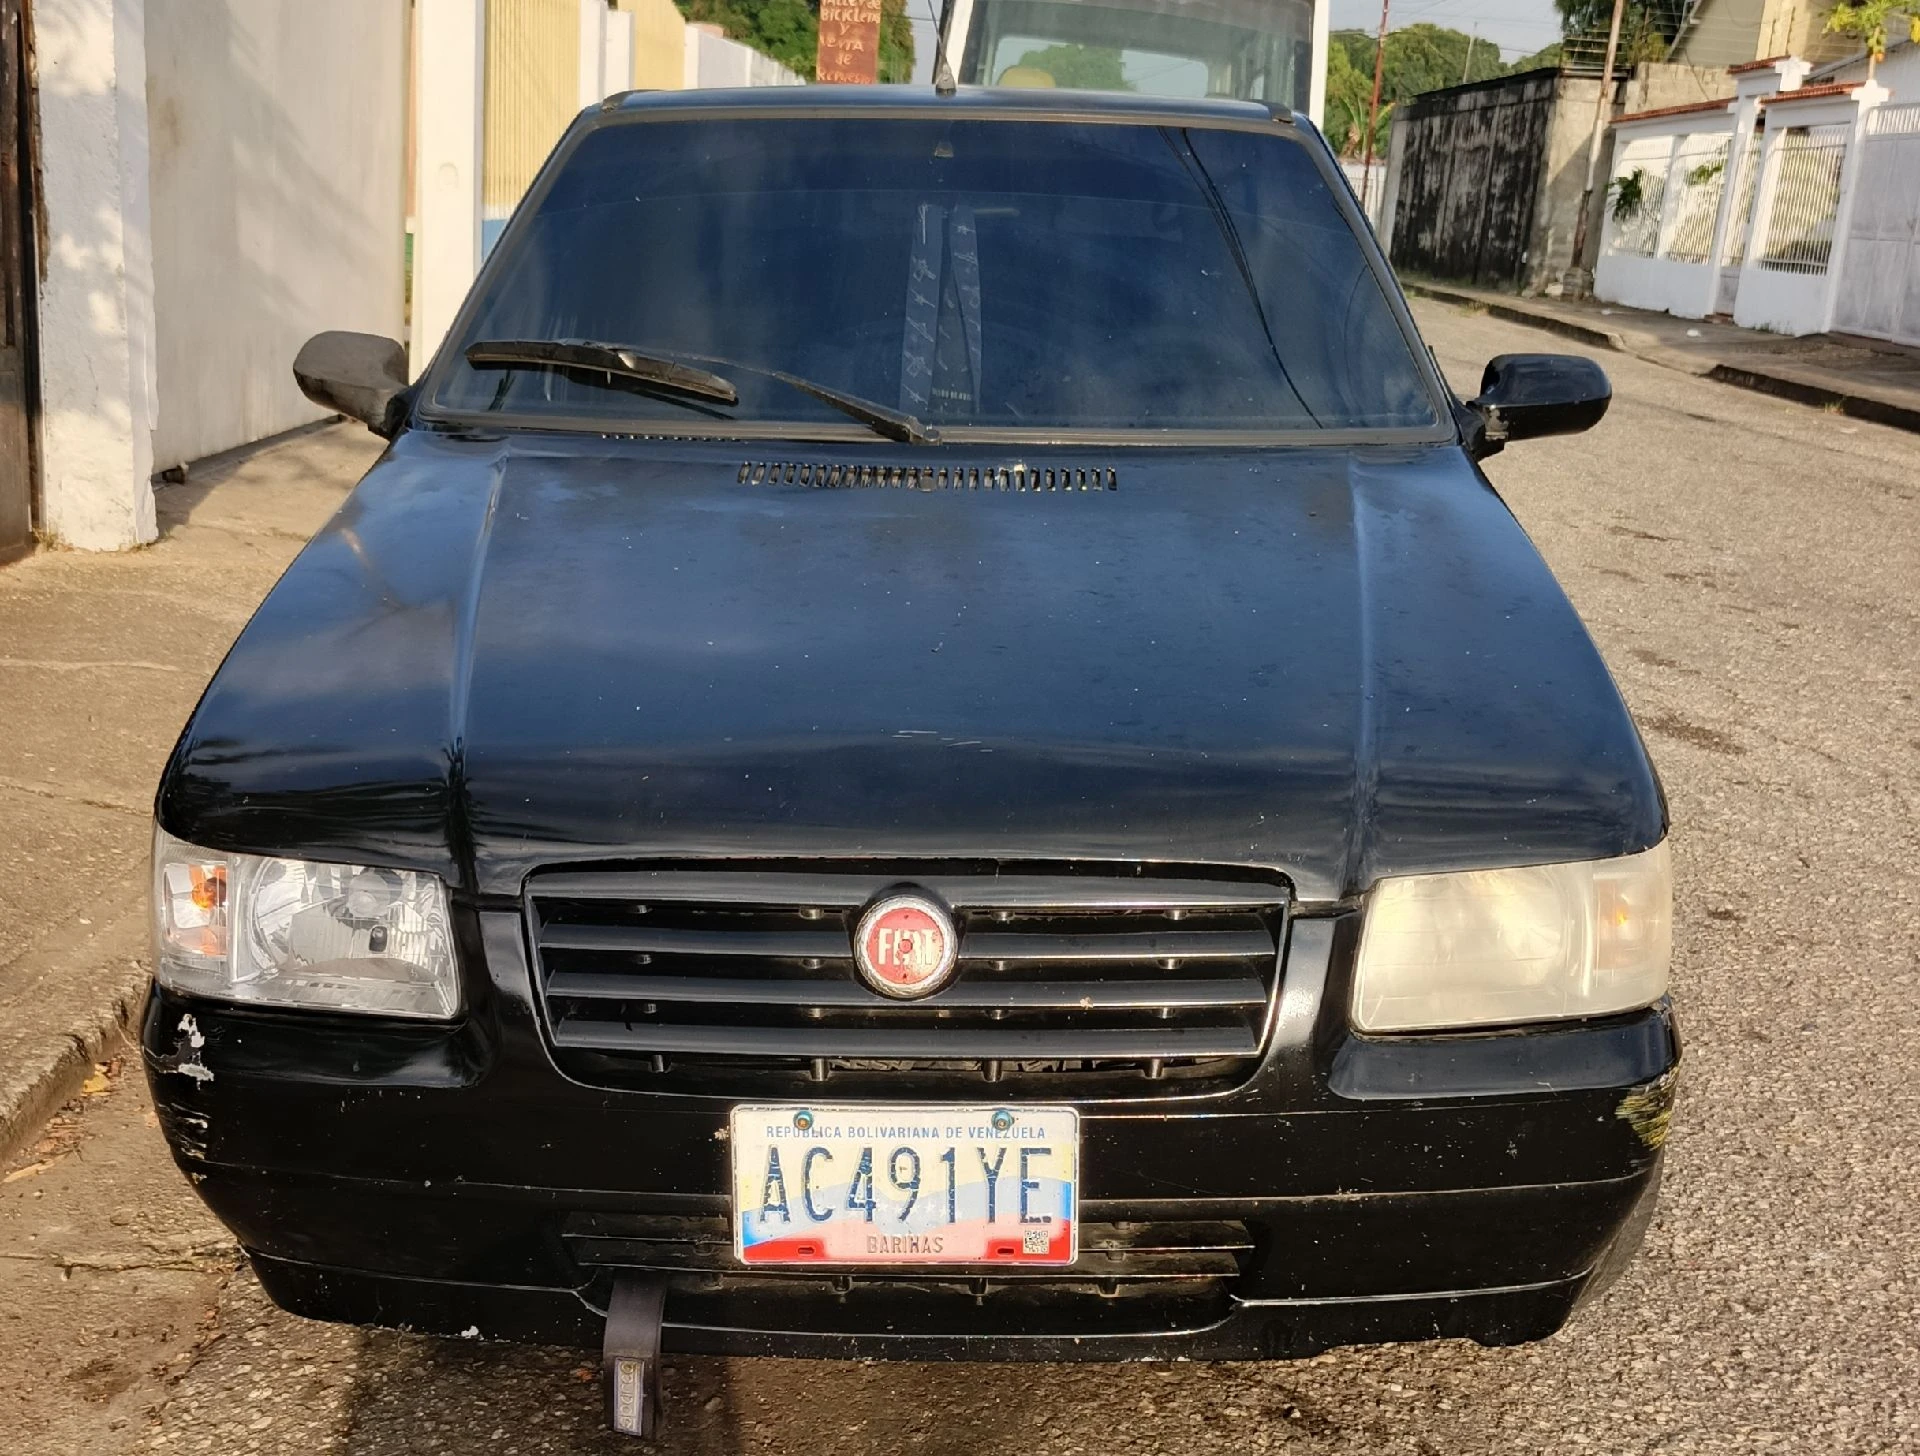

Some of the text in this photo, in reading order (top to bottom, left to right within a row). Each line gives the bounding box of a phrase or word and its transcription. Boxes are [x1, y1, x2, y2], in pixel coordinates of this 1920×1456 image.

[877, 928, 934, 965] FIAT
[848, 1126, 940, 1139] BOLIVARIANA
[946, 1127, 962, 1139] DE
[968, 1127, 1045, 1139] VENEZUELA
[760, 1146, 1052, 1223] AC491YE
[867, 1236, 943, 1254] BARINAS
